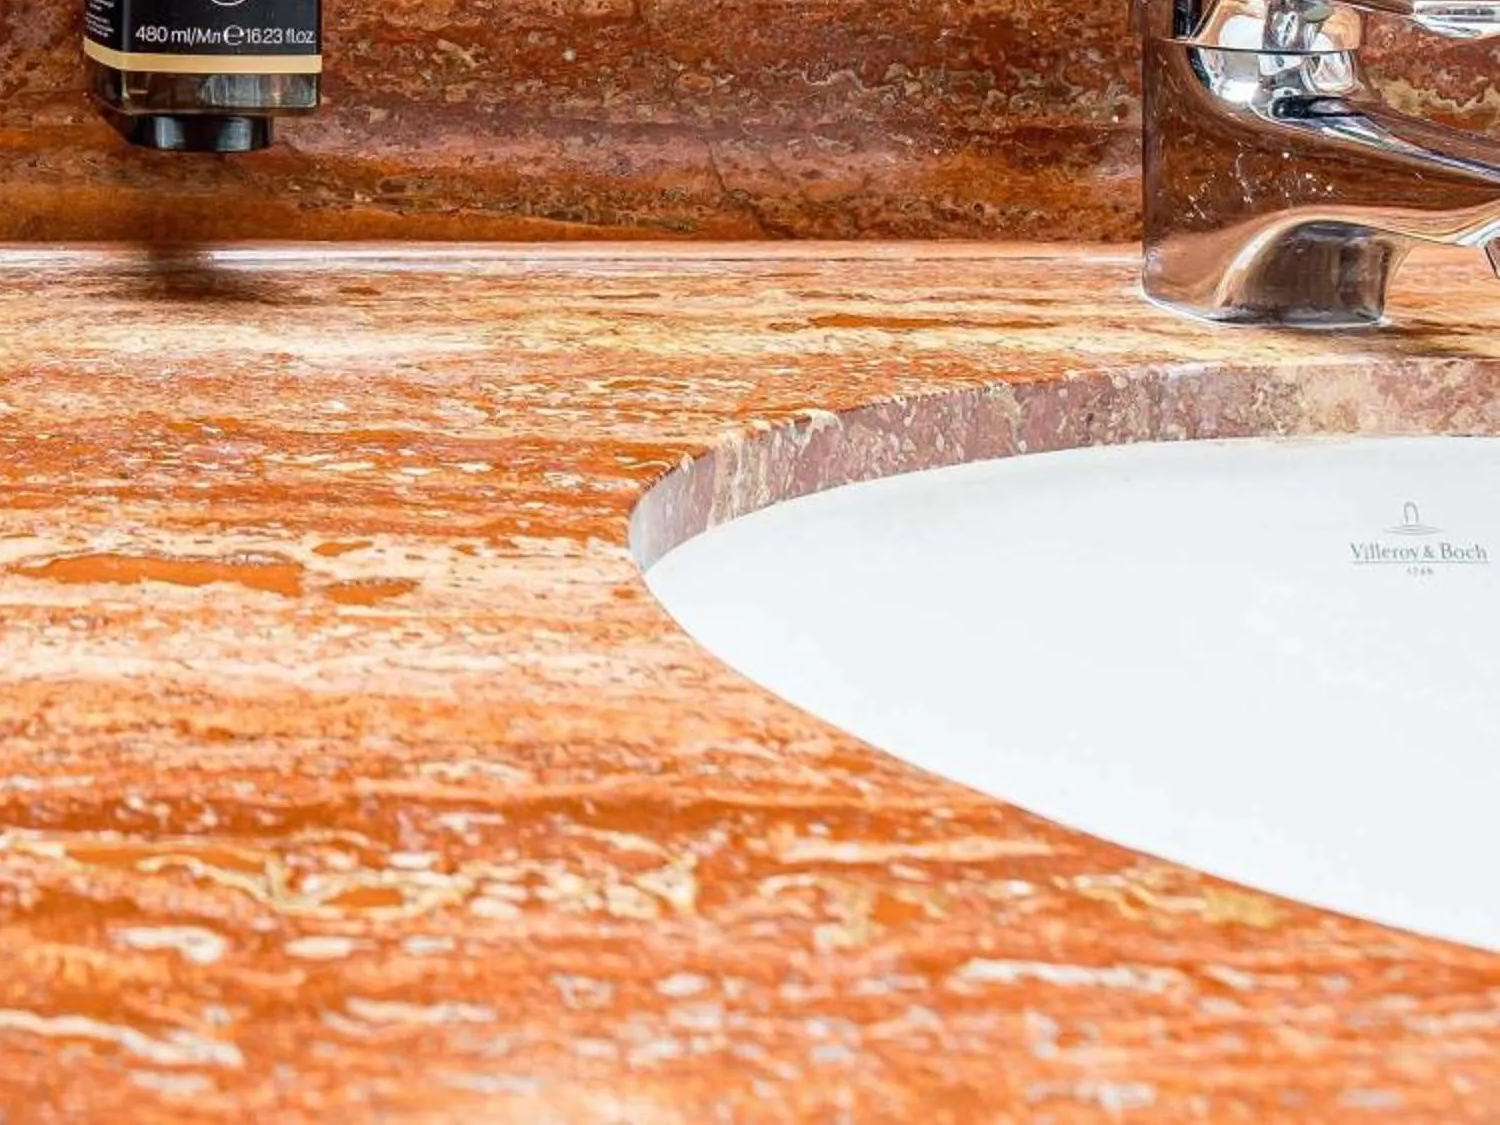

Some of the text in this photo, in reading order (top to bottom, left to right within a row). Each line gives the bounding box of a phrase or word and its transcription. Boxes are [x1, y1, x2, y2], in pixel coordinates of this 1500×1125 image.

[135, 26, 169, 43] 480
[1350, 542, 1488, 561] Villeroy & Boch
